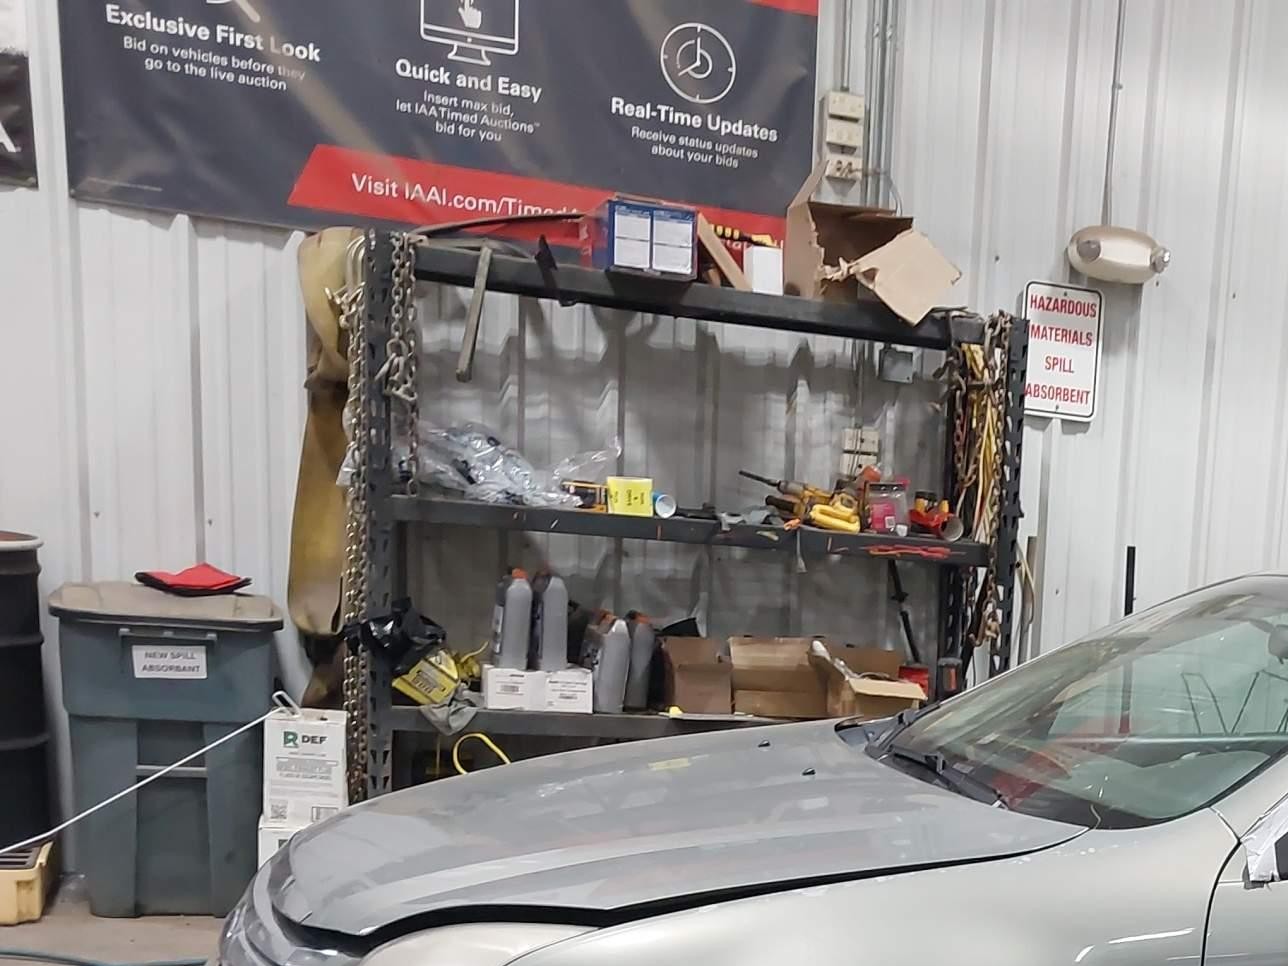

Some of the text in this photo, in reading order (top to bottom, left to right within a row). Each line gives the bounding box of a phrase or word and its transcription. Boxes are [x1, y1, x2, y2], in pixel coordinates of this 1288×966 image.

[105, 4, 321, 62] Exclusive First Look
[123, 35, 306, 81] Bid on vehicles before they
[145, 57, 287, 91] go to the live auction
[395, 58, 542, 103] Quick and Easy
[396, 99, 412, 113] let
[423, 90, 458, 107] Insert
[462, 98, 488, 112] max
[435, 121, 502, 142] bid for you
[611, 97, 778, 142] Real-Time Updates
[631, 126, 758, 159] Receive status updates
[651, 144, 739, 168] about your bids
[351, 172, 398, 198] Visit
[1030, 294, 1097, 318] HAZARDOUS
[1030, 324, 1093, 347] MATERIALS
[1045, 356, 1074, 374] SPILL
[1024, 383, 1091, 405] ABSORBENT
[301, 735, 328, 744] DEF
